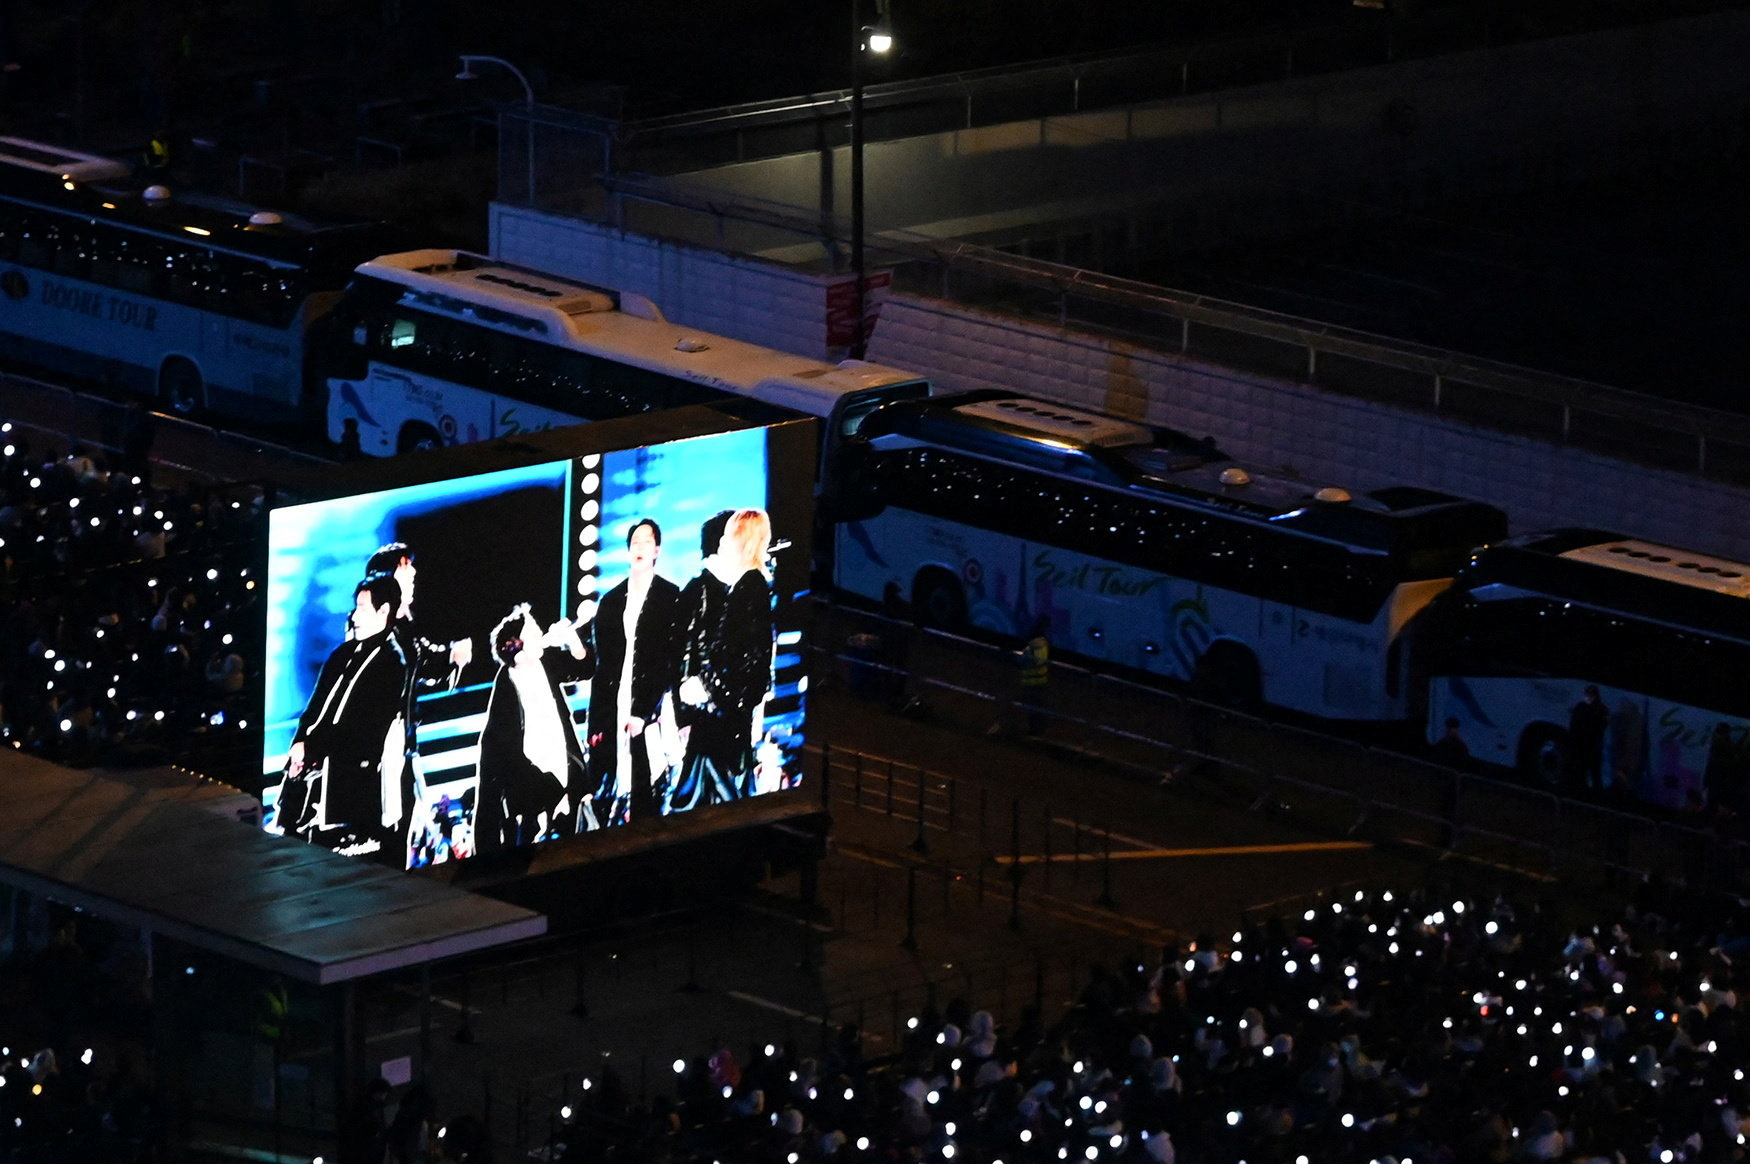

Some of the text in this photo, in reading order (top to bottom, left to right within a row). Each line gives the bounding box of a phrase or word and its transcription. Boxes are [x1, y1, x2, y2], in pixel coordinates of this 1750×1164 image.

[107, 297, 158, 331] TOUR
[1033, 550, 1174, 597] Seil Tour
[1659, 707, 1716, 748] Sei
